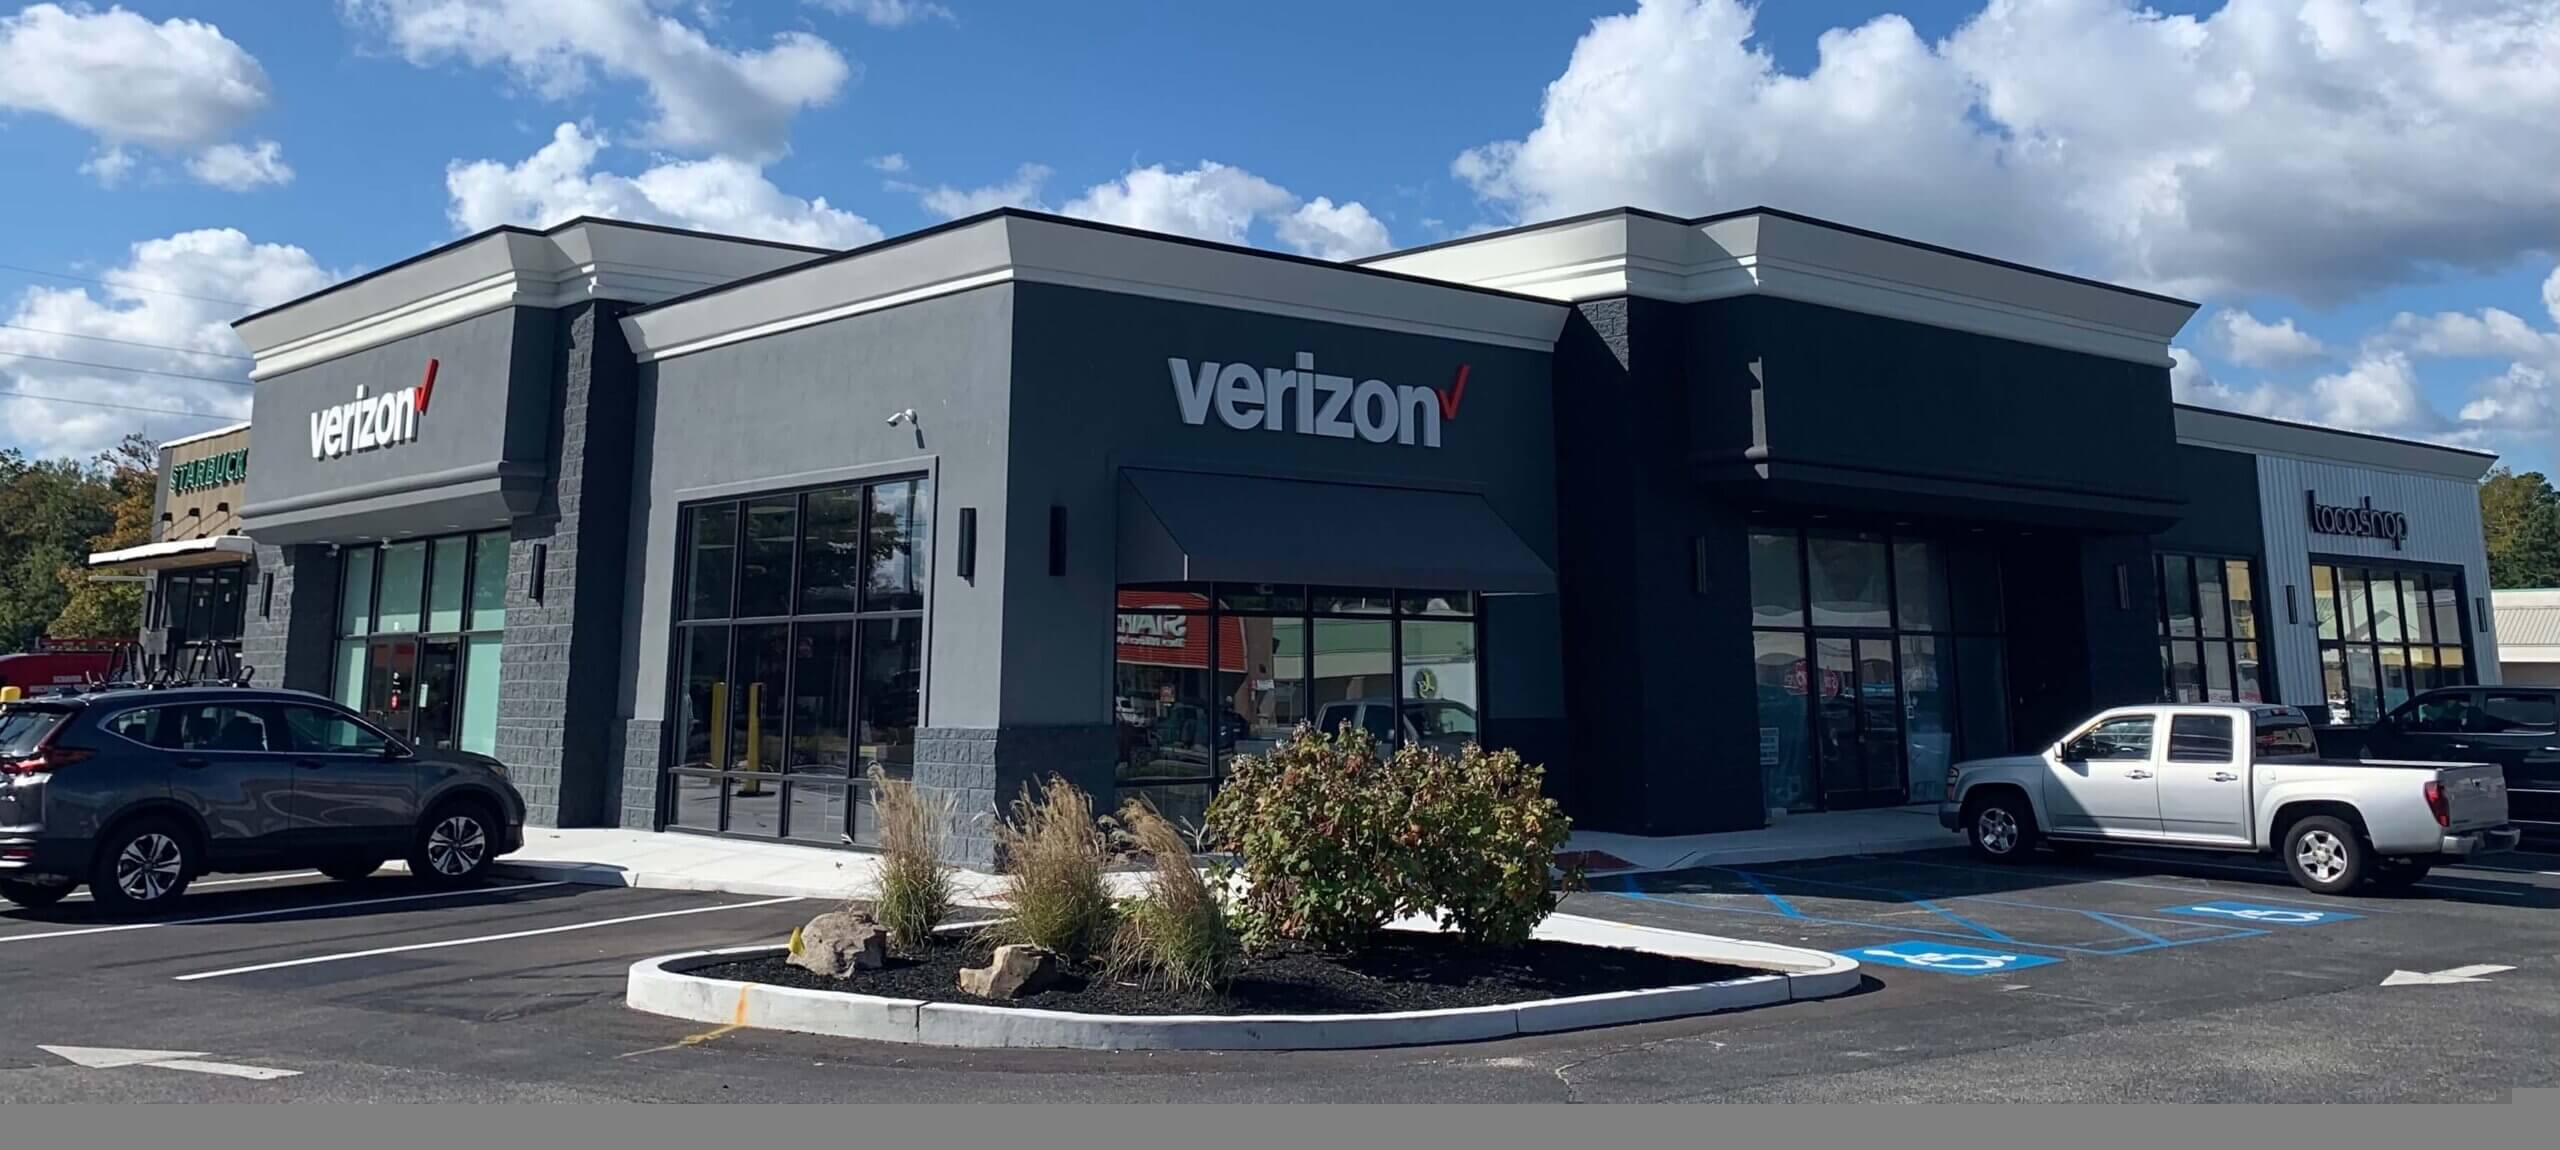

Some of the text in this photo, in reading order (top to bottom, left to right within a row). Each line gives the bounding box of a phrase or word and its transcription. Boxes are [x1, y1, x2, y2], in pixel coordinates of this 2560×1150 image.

[310, 383, 418, 460] verizon
[1167, 351, 1441, 448] verizon
[169, 447, 248, 494] STARBUCK
